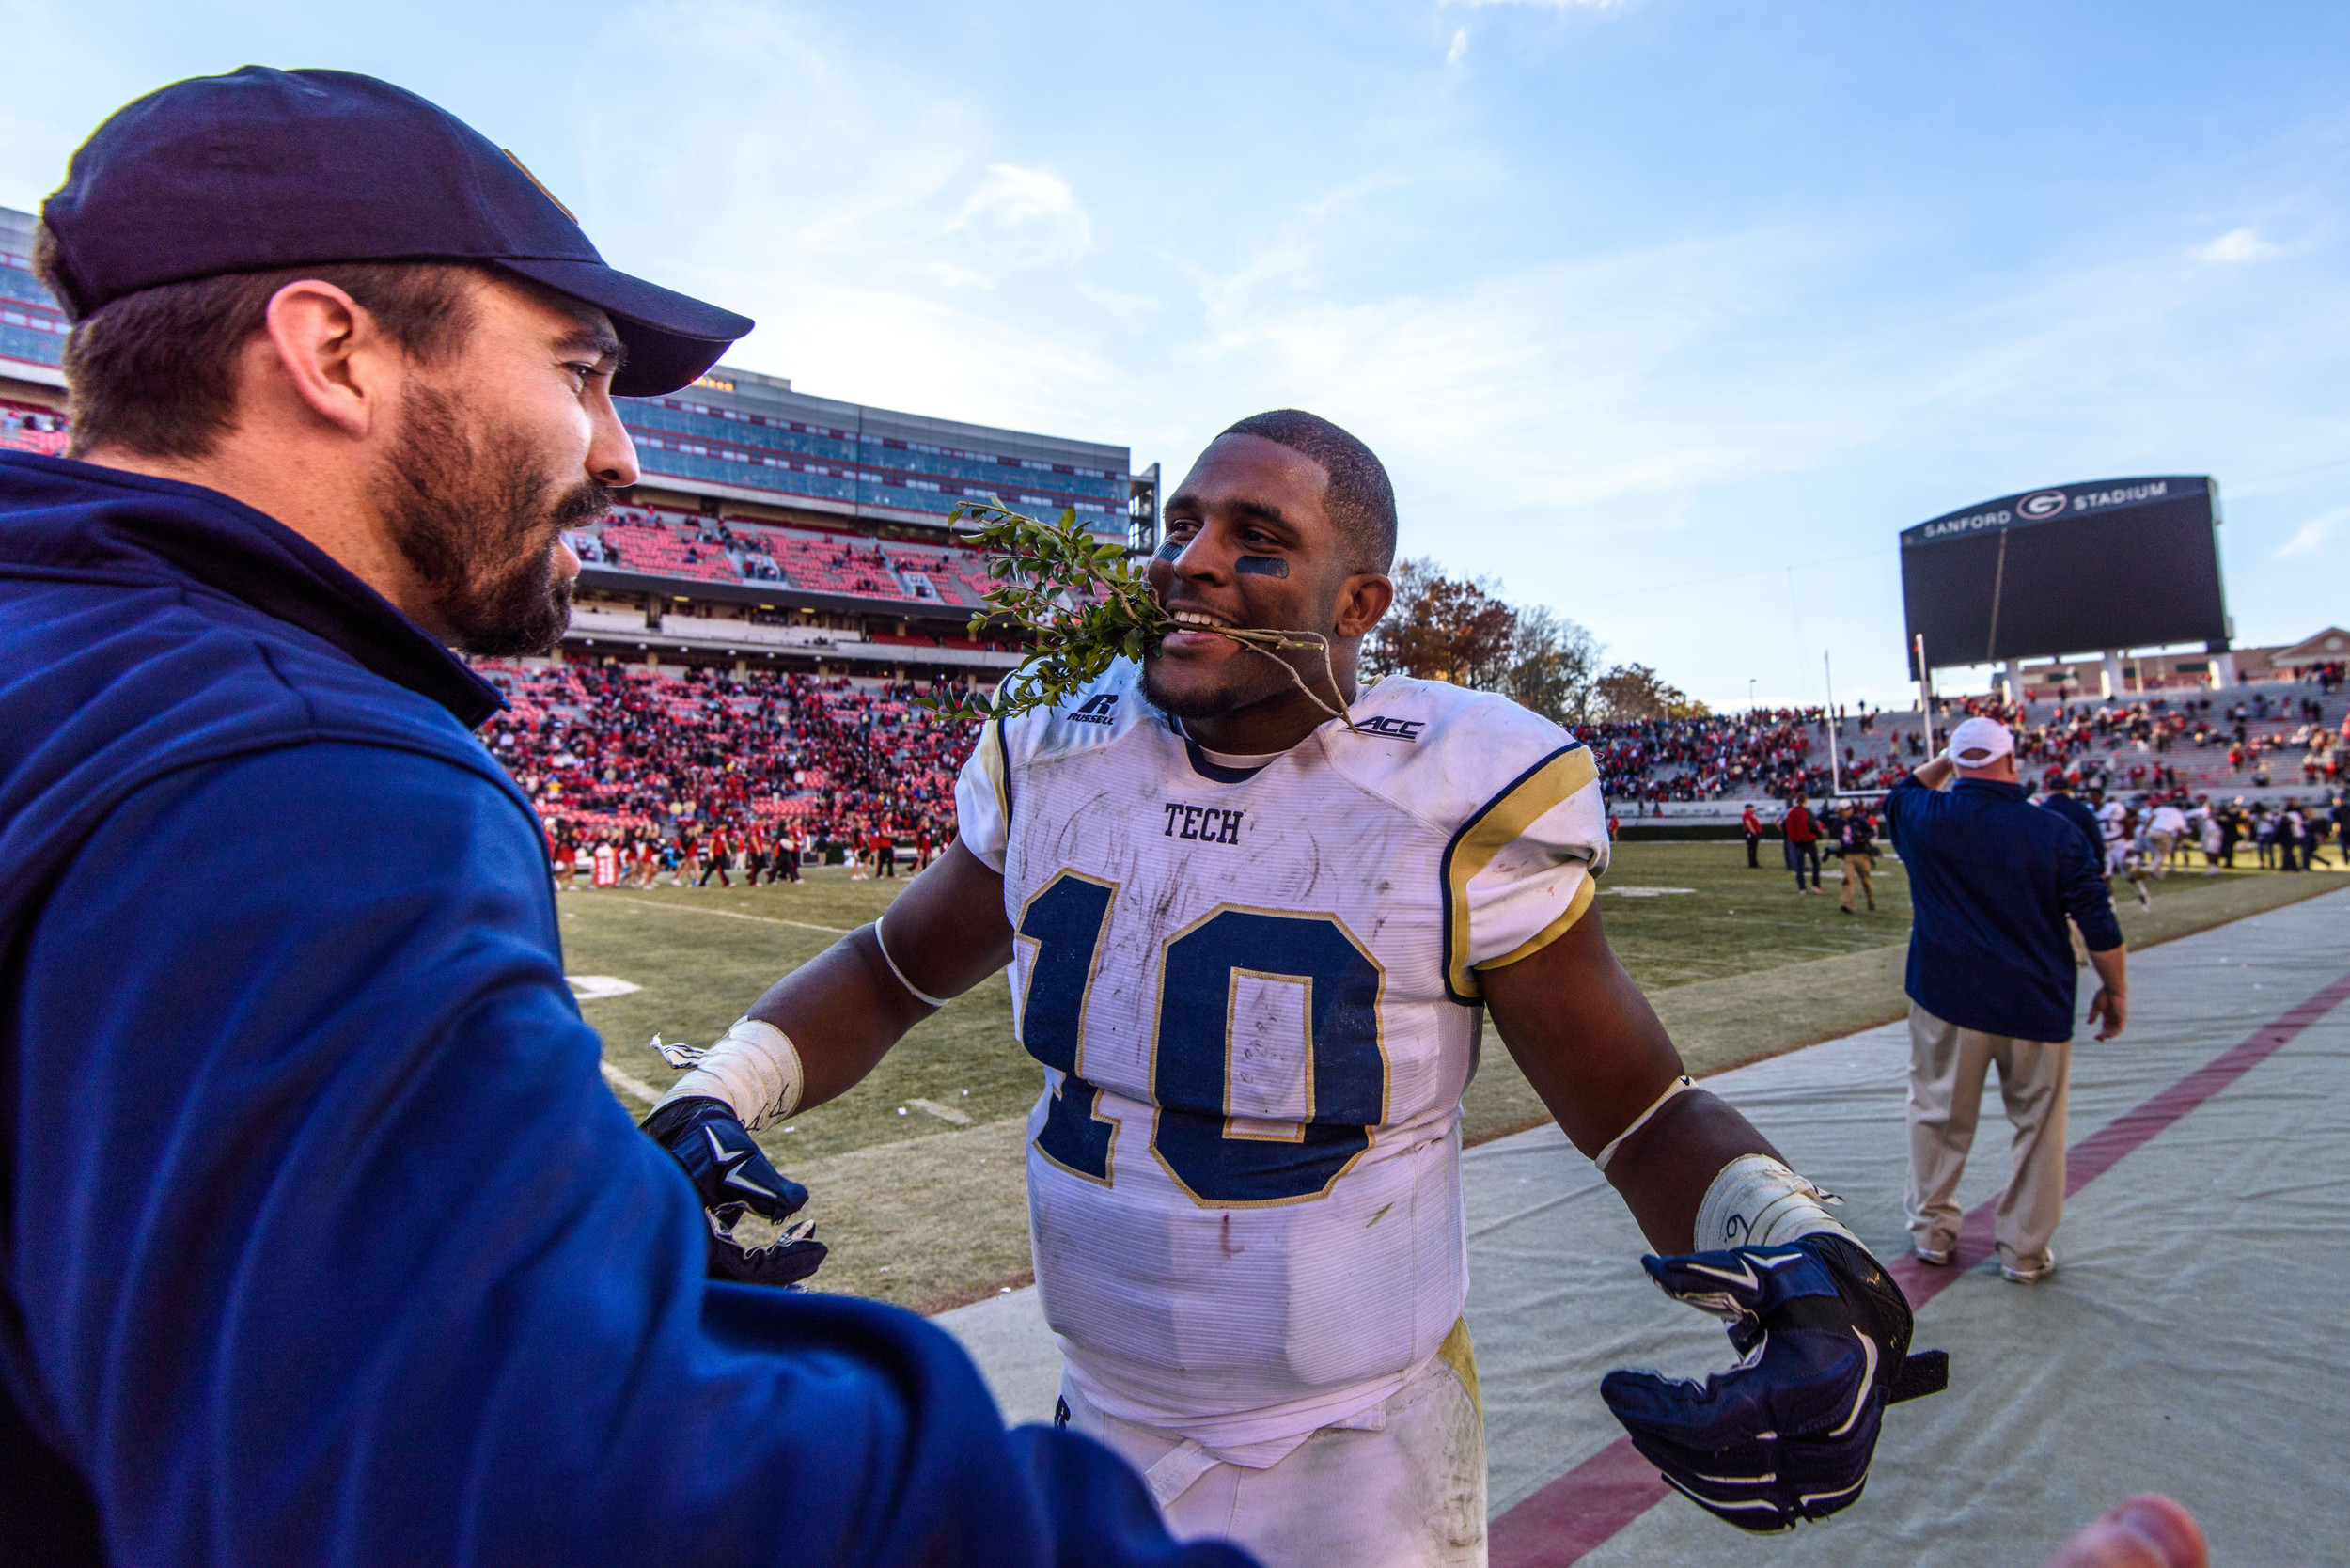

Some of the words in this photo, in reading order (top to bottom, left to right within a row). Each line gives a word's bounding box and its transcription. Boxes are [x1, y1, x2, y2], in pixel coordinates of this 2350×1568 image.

[1923, 510, 2011, 538] SANFORD
[2073, 481, 2167, 510] STADIUM
[1067, 713, 1114, 726] RUSSELL
[1354, 715, 1426, 736] ACC
[1165, 803, 1244, 846] TECH
[1016, 867, 1390, 1209] 10
